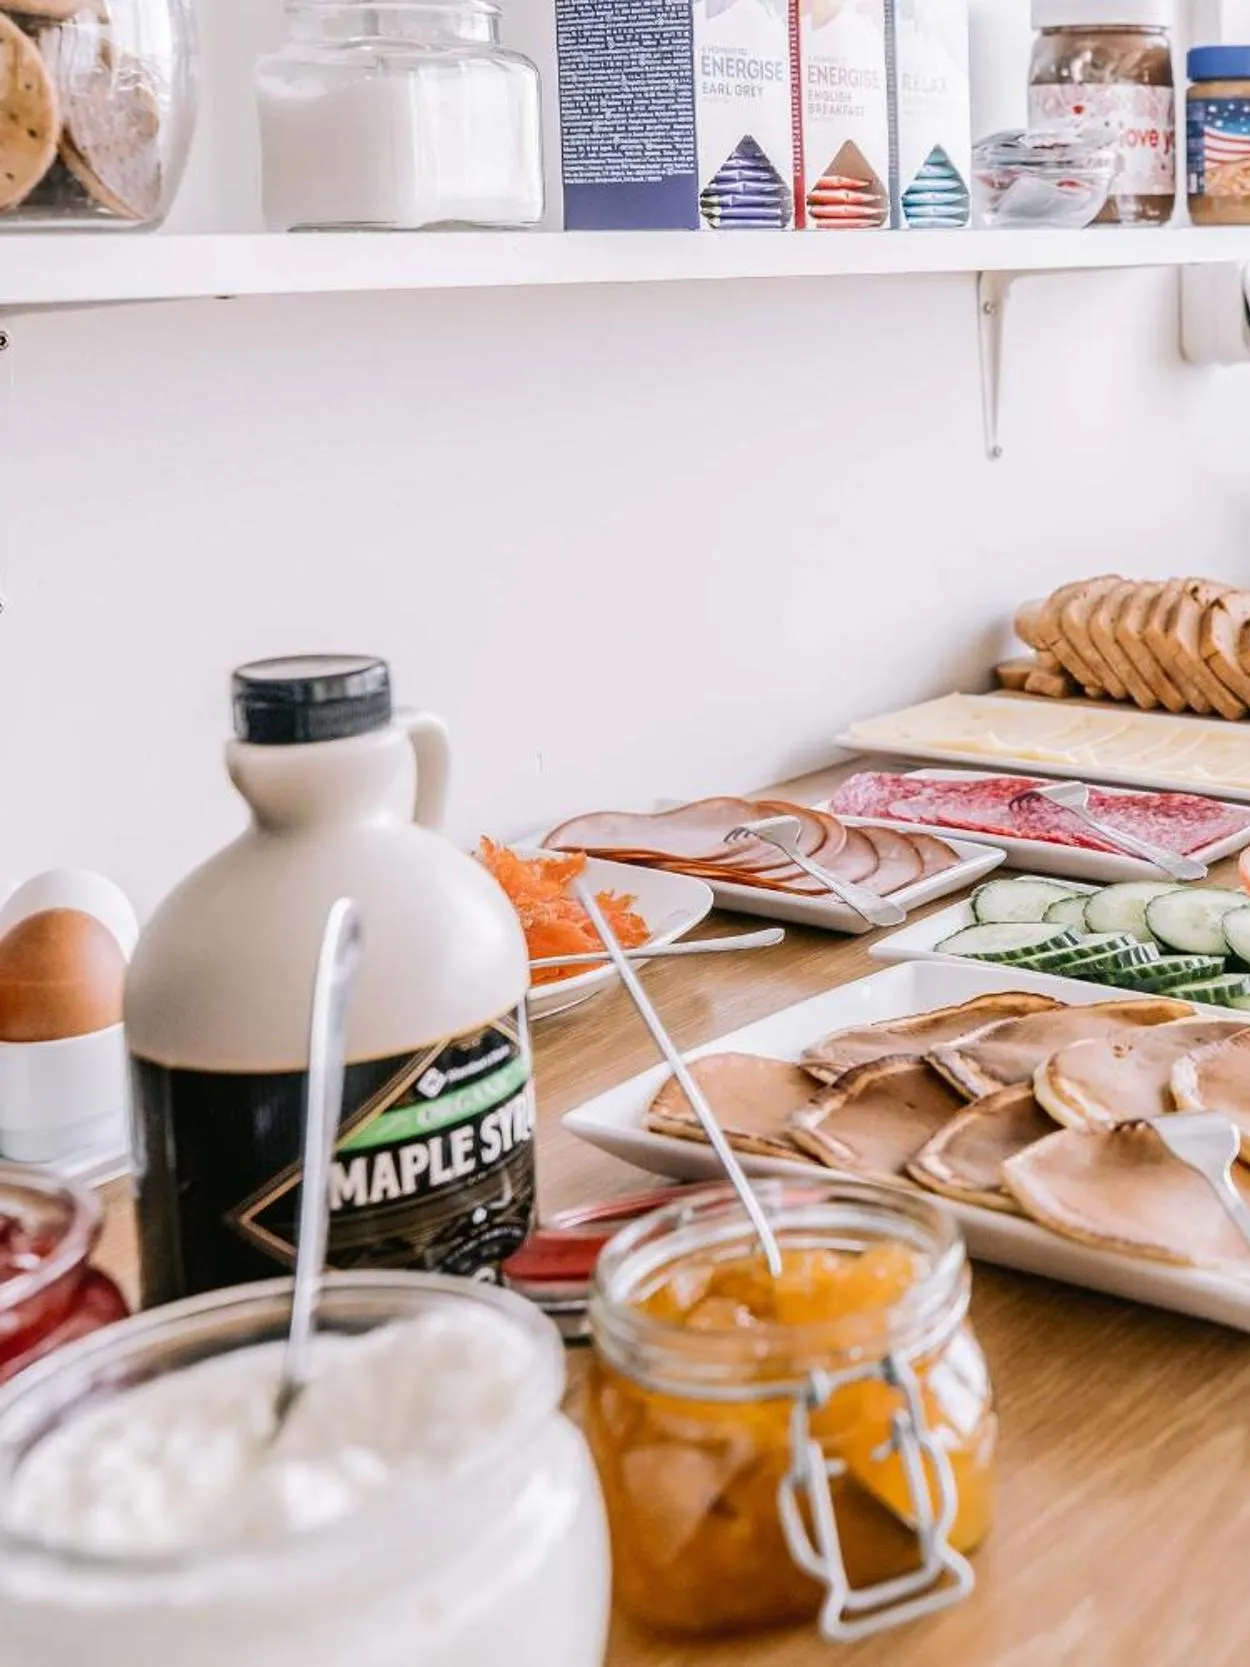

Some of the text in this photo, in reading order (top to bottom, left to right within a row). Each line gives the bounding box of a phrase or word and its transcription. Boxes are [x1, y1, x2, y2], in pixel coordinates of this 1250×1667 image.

[701, 55, 783, 81] ENERGISE
[807, 64, 881, 89] ENERGISE
[702, 81, 764, 98] EARL GREY
[807, 102, 865, 117] BREAKFAST
[328, 1086, 535, 1211] MAPLE SYR
